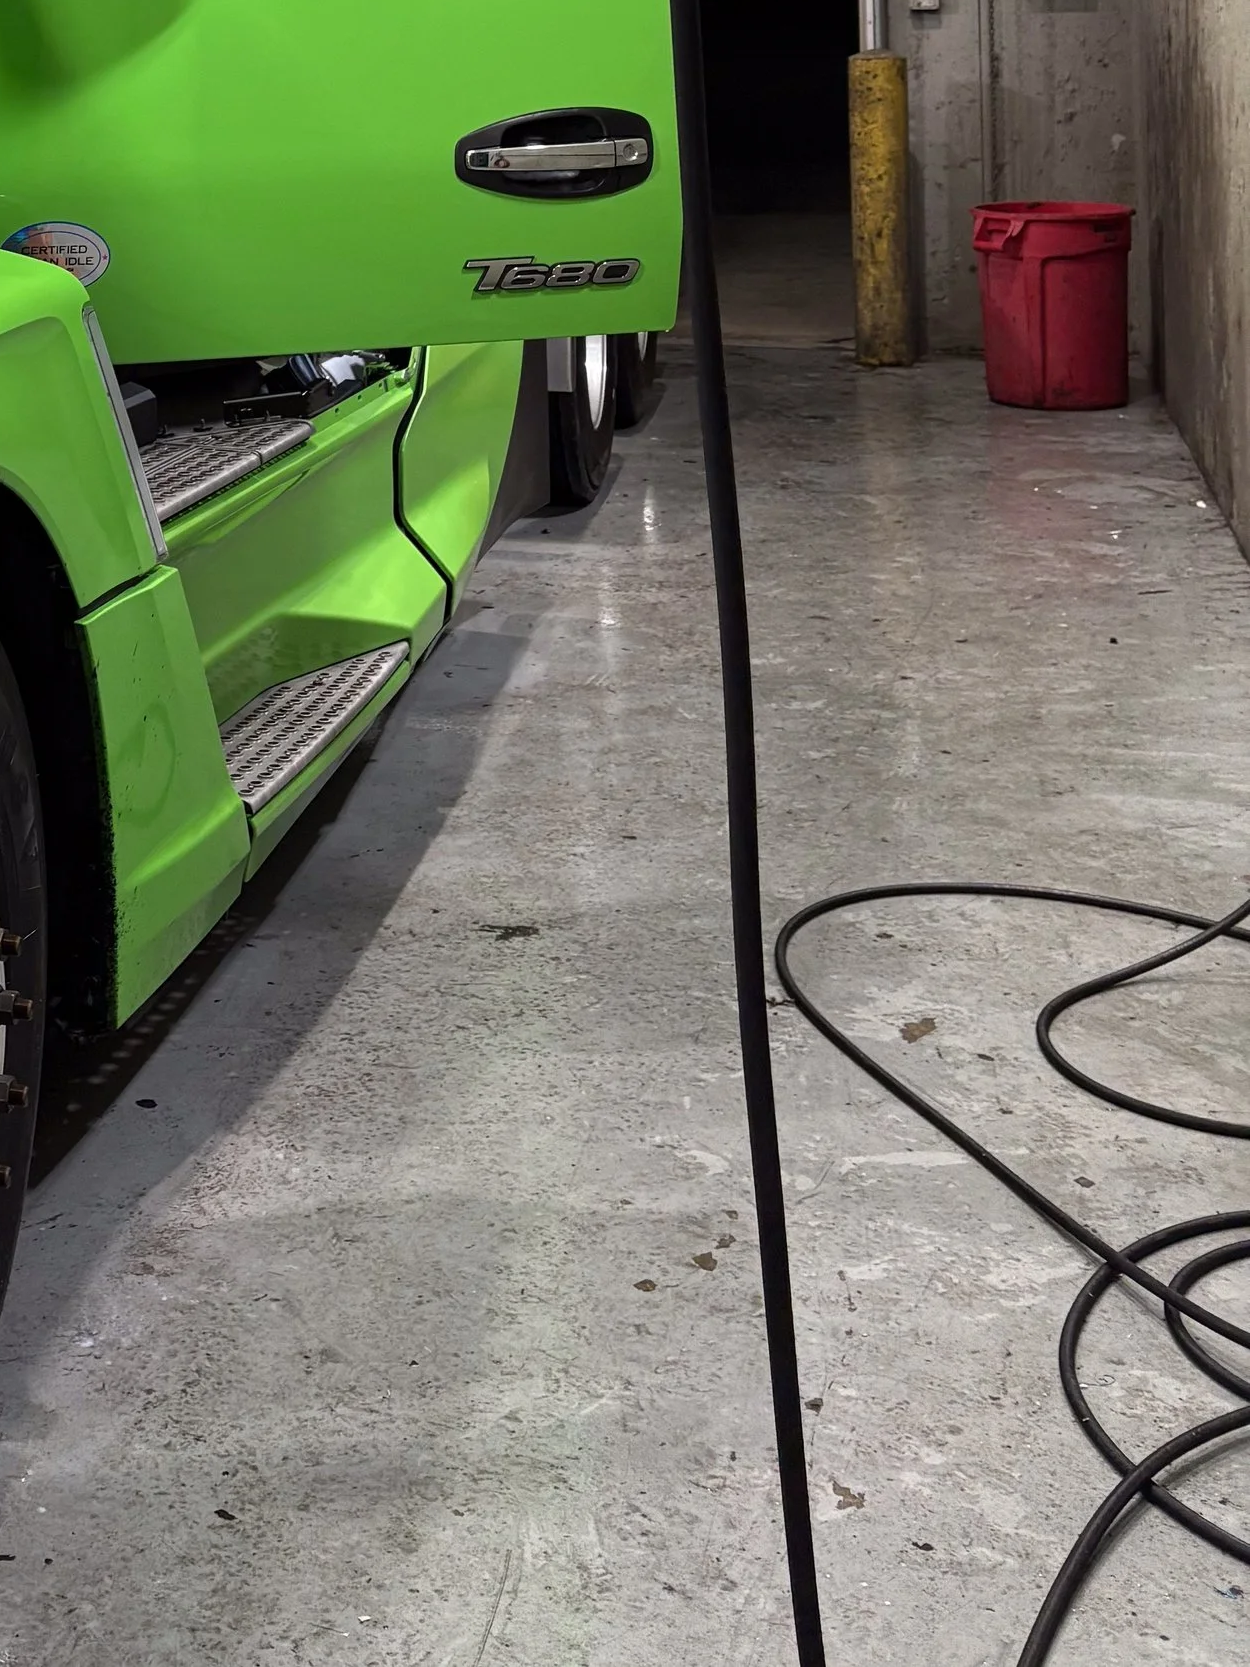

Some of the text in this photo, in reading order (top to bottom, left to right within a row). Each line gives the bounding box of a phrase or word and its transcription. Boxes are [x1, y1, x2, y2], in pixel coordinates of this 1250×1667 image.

[20, 244, 88, 255] CERTIFIED
[65, 256, 94, 266] IDLE
[463, 256, 640, 292] T680
